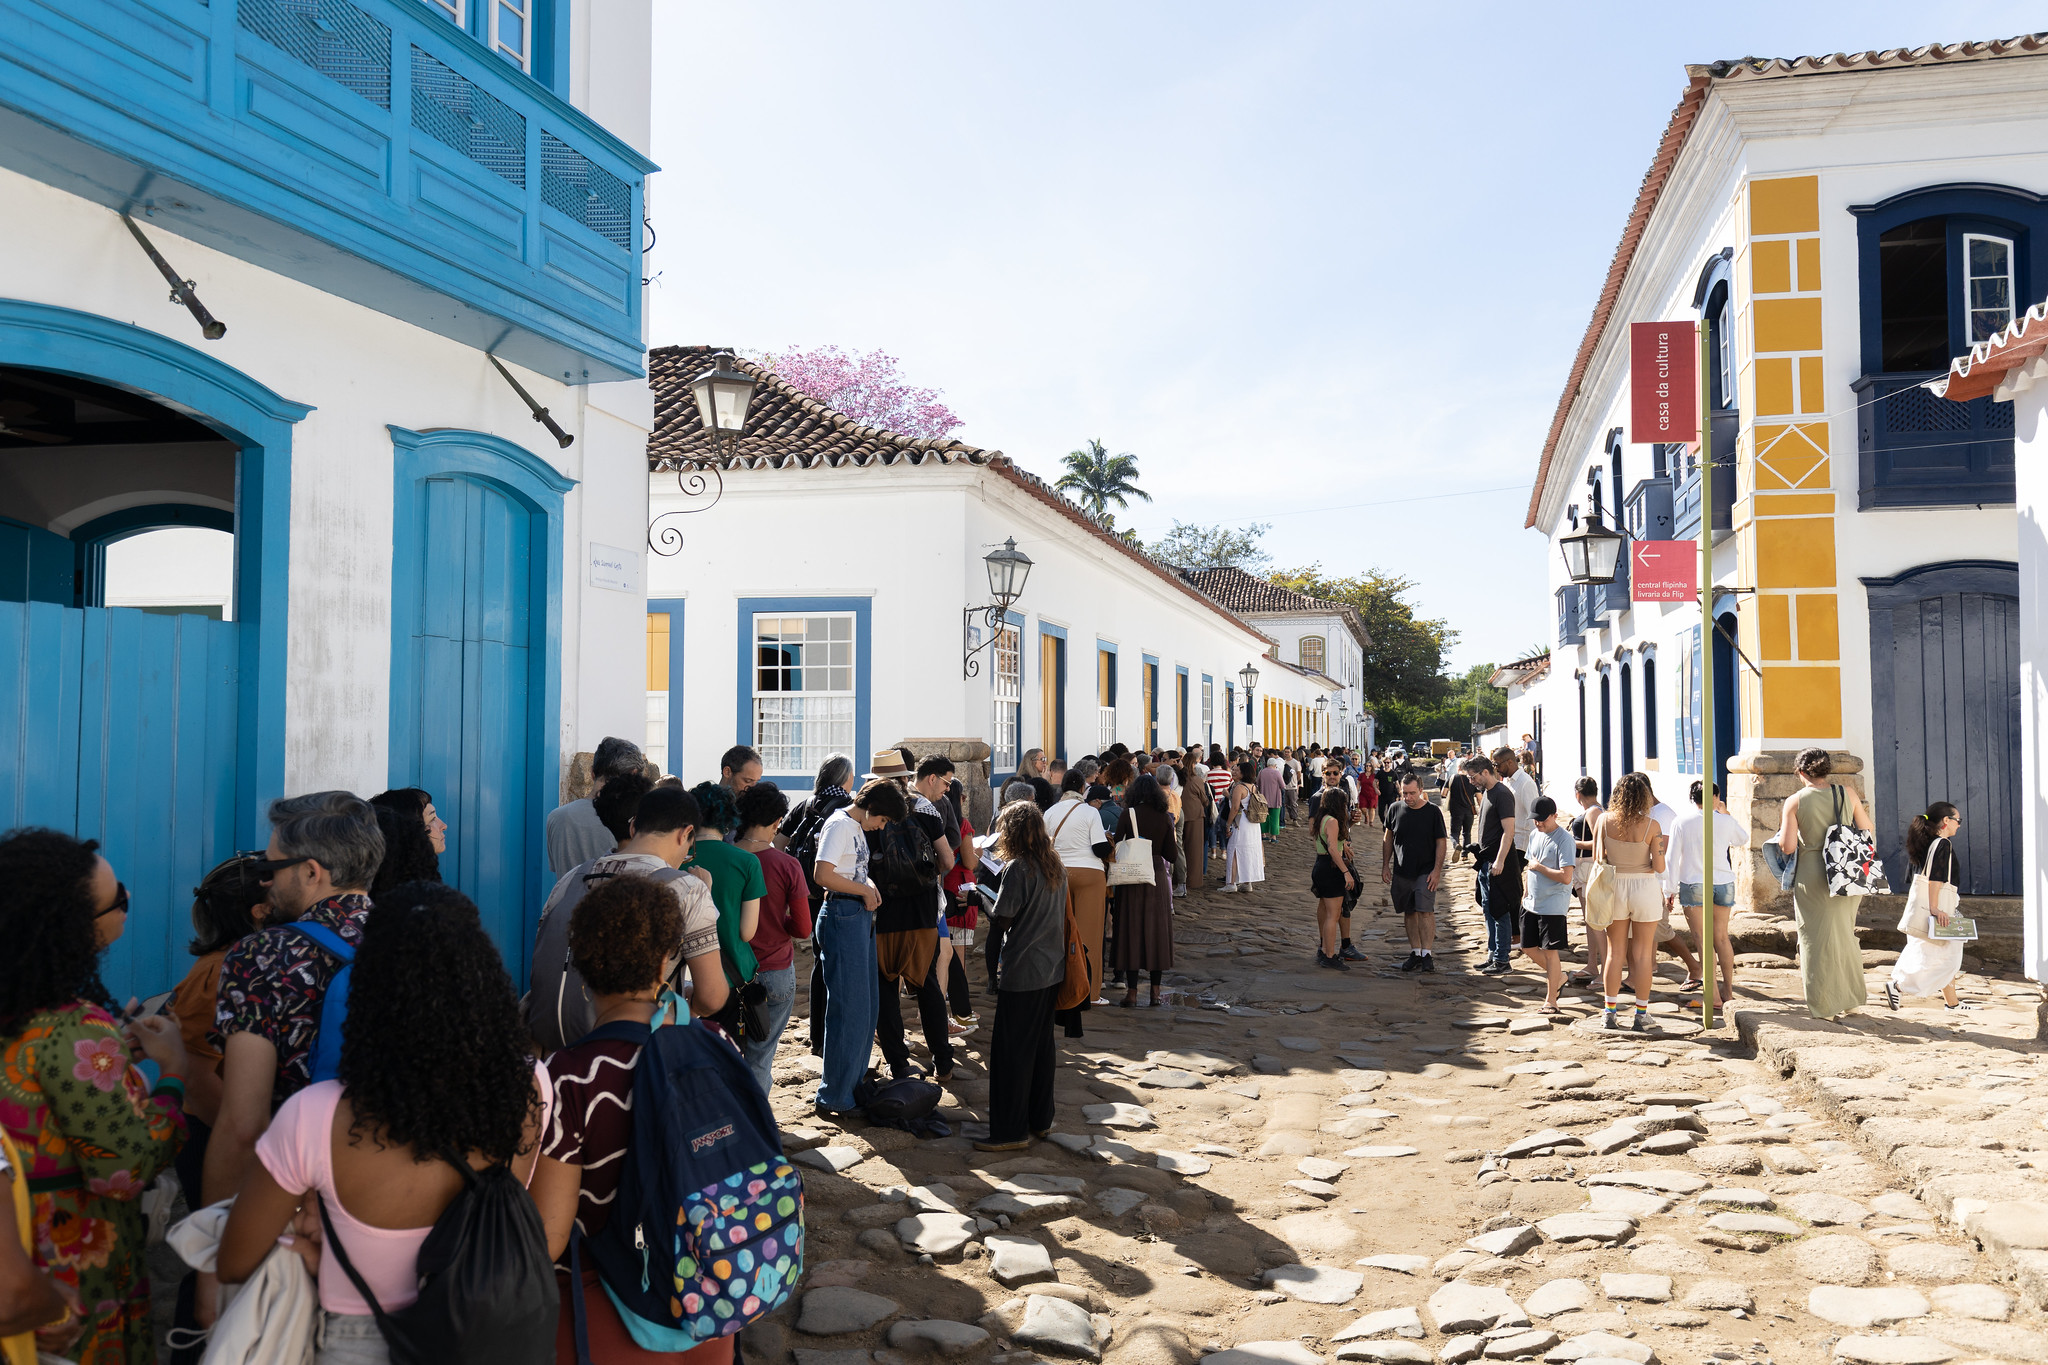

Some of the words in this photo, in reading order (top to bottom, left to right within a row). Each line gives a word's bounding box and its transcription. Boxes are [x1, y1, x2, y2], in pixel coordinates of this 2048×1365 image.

[1656, 333, 1669, 378] cultura
[1656, 382, 1669, 398] da
[1659, 402, 1669, 431] casa
[1637, 581, 1661, 589] central
[1662, 581, 1688, 590] flipinha
[1637, 590, 1661, 598] livraria
[1661, 590, 1671, 598] da
[1672, 590, 1685, 599] Flip
[690, 1123, 735, 1153] JANSPORT
